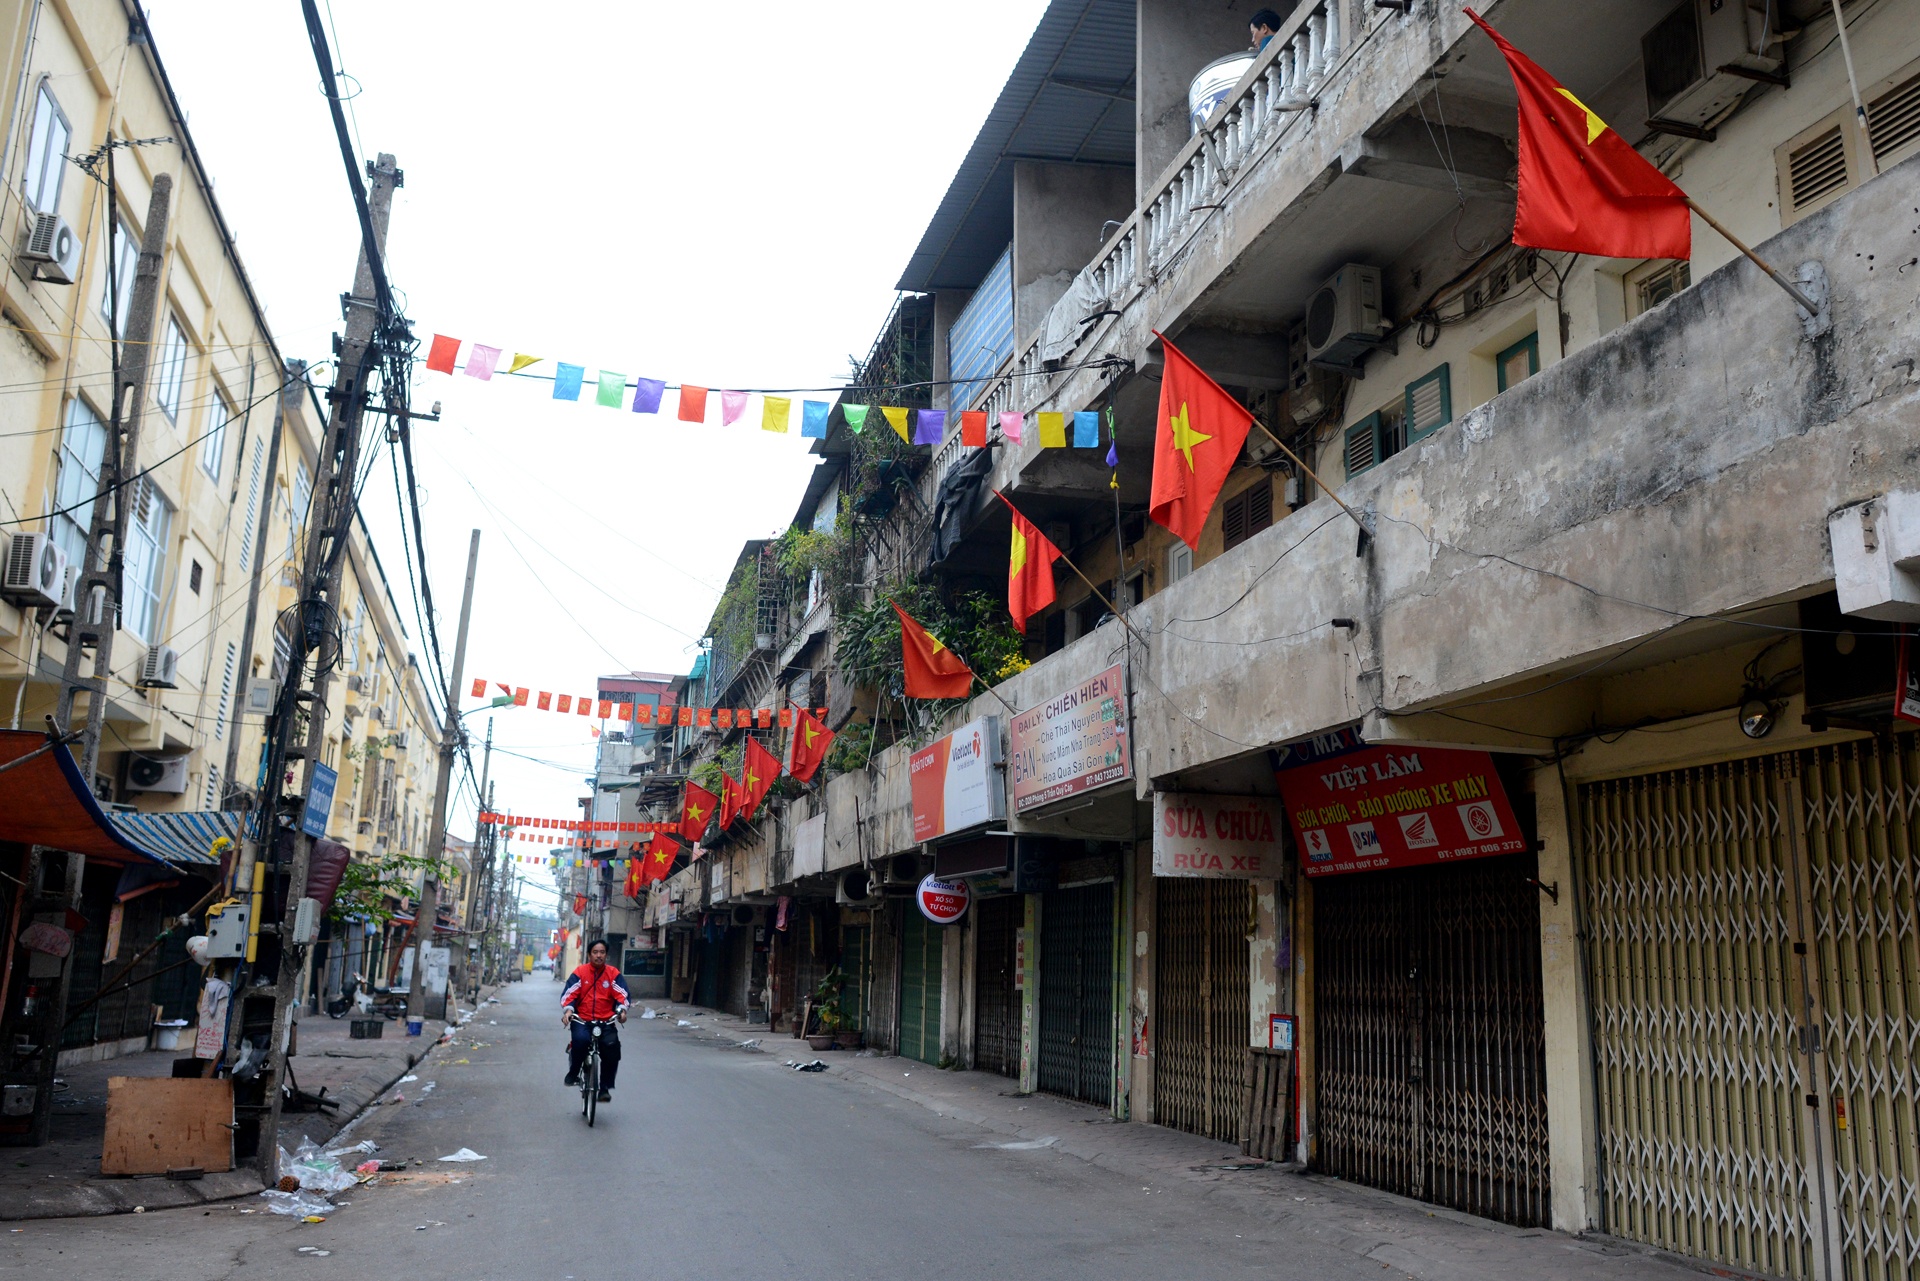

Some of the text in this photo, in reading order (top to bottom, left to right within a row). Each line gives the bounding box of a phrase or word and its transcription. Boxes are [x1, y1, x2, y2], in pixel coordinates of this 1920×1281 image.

[1018, 719, 1031, 734] ĐẠI
[1045, 692, 1078, 720] CHIẾN
[1080, 677, 1108, 704] HIỀN
[1055, 722, 1070, 738] Thái
[1071, 710, 1101, 732] Nguyên
[1070, 737, 1083, 753] Nha
[1083, 734, 1101, 749] Trang
[1102, 725, 1114, 741] 584
[951, 741, 972, 762] Vietlott
[1042, 772, 1056, 784] Hoa
[1320, 753, 1423, 791] VIỆT LÂM
[1296, 803, 1320, 829] SỬA
[1319, 801, 1351, 825] CHỮA
[1357, 791, 1384, 819] BẢO
[1384, 786, 1432, 814] DƯỠNG
[1430, 783, 1454, 805] XE
[1452, 773, 1489, 801] MÁY
[1163, 798, 1275, 842] SỬA CHỮA
[1361, 830, 1379, 847] SYM
[1408, 838, 1437, 847] HONDA
[1454, 846, 1478, 857] 0987
[1480, 843, 1500, 853] 006
[1501, 840, 1523, 850] 373
[1174, 847, 1261, 871] RỬA XE
[1309, 852, 1333, 863] SUZUKI
[926, 880, 955, 891] Vietlott
[930, 903, 958, 913] TỰ CHỌN
